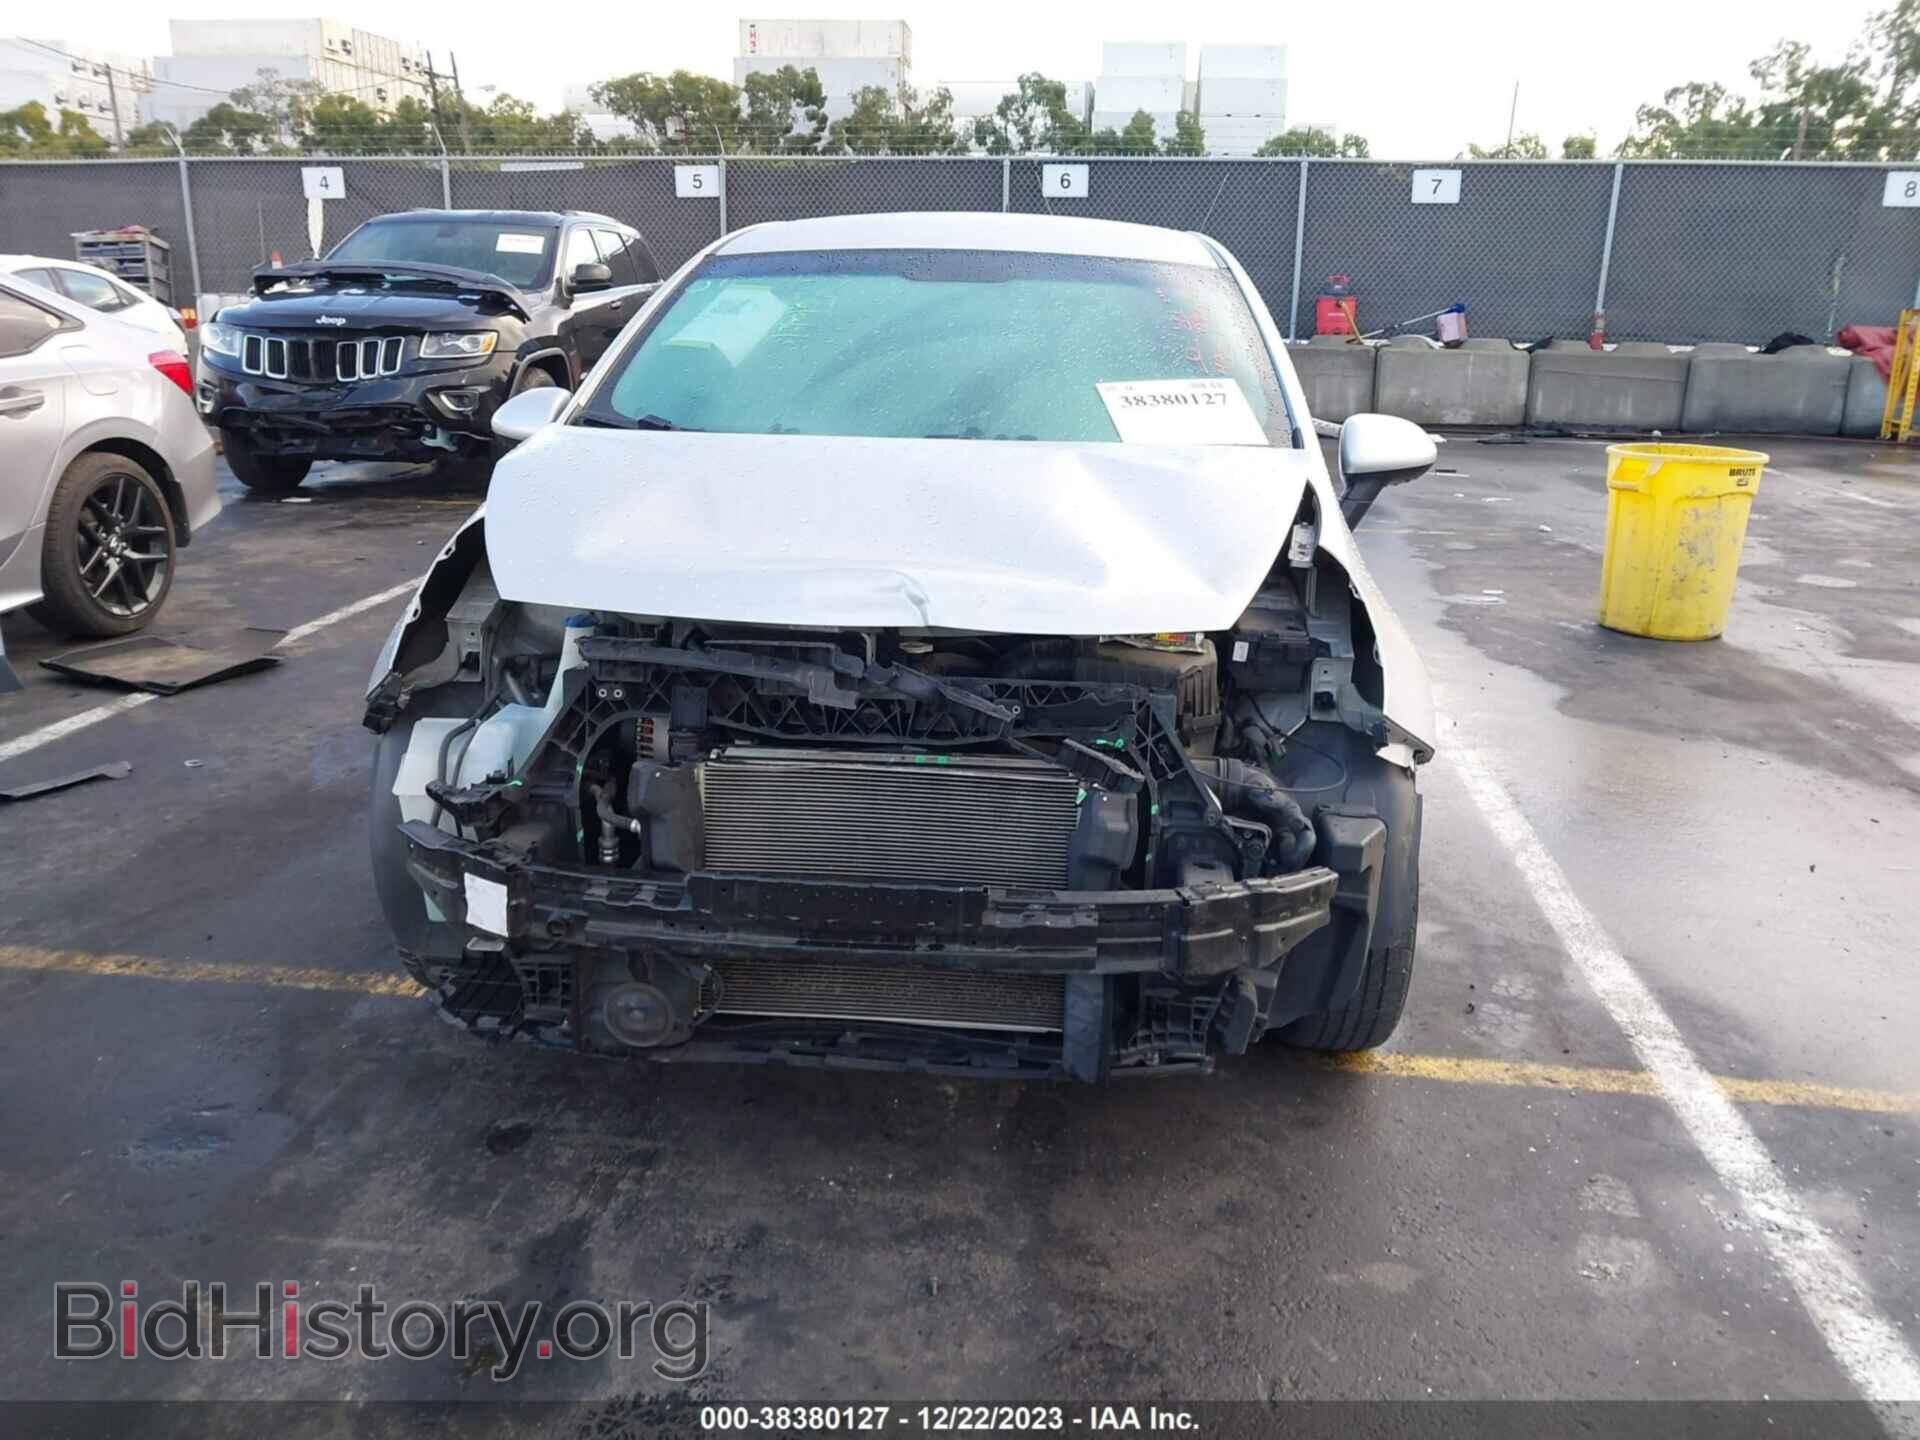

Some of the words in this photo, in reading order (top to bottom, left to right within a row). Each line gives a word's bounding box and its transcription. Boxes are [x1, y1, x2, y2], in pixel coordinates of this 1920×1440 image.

[319, 175, 329, 190] 4
[692, 173, 703, 189] 5
[1060, 172, 1071, 189] 6
[1431, 178, 1443, 195] 7
[1904, 180, 1917, 198] 8
[315, 314, 346, 327] Jeep
[1120, 392, 1227, 408] 38380127
